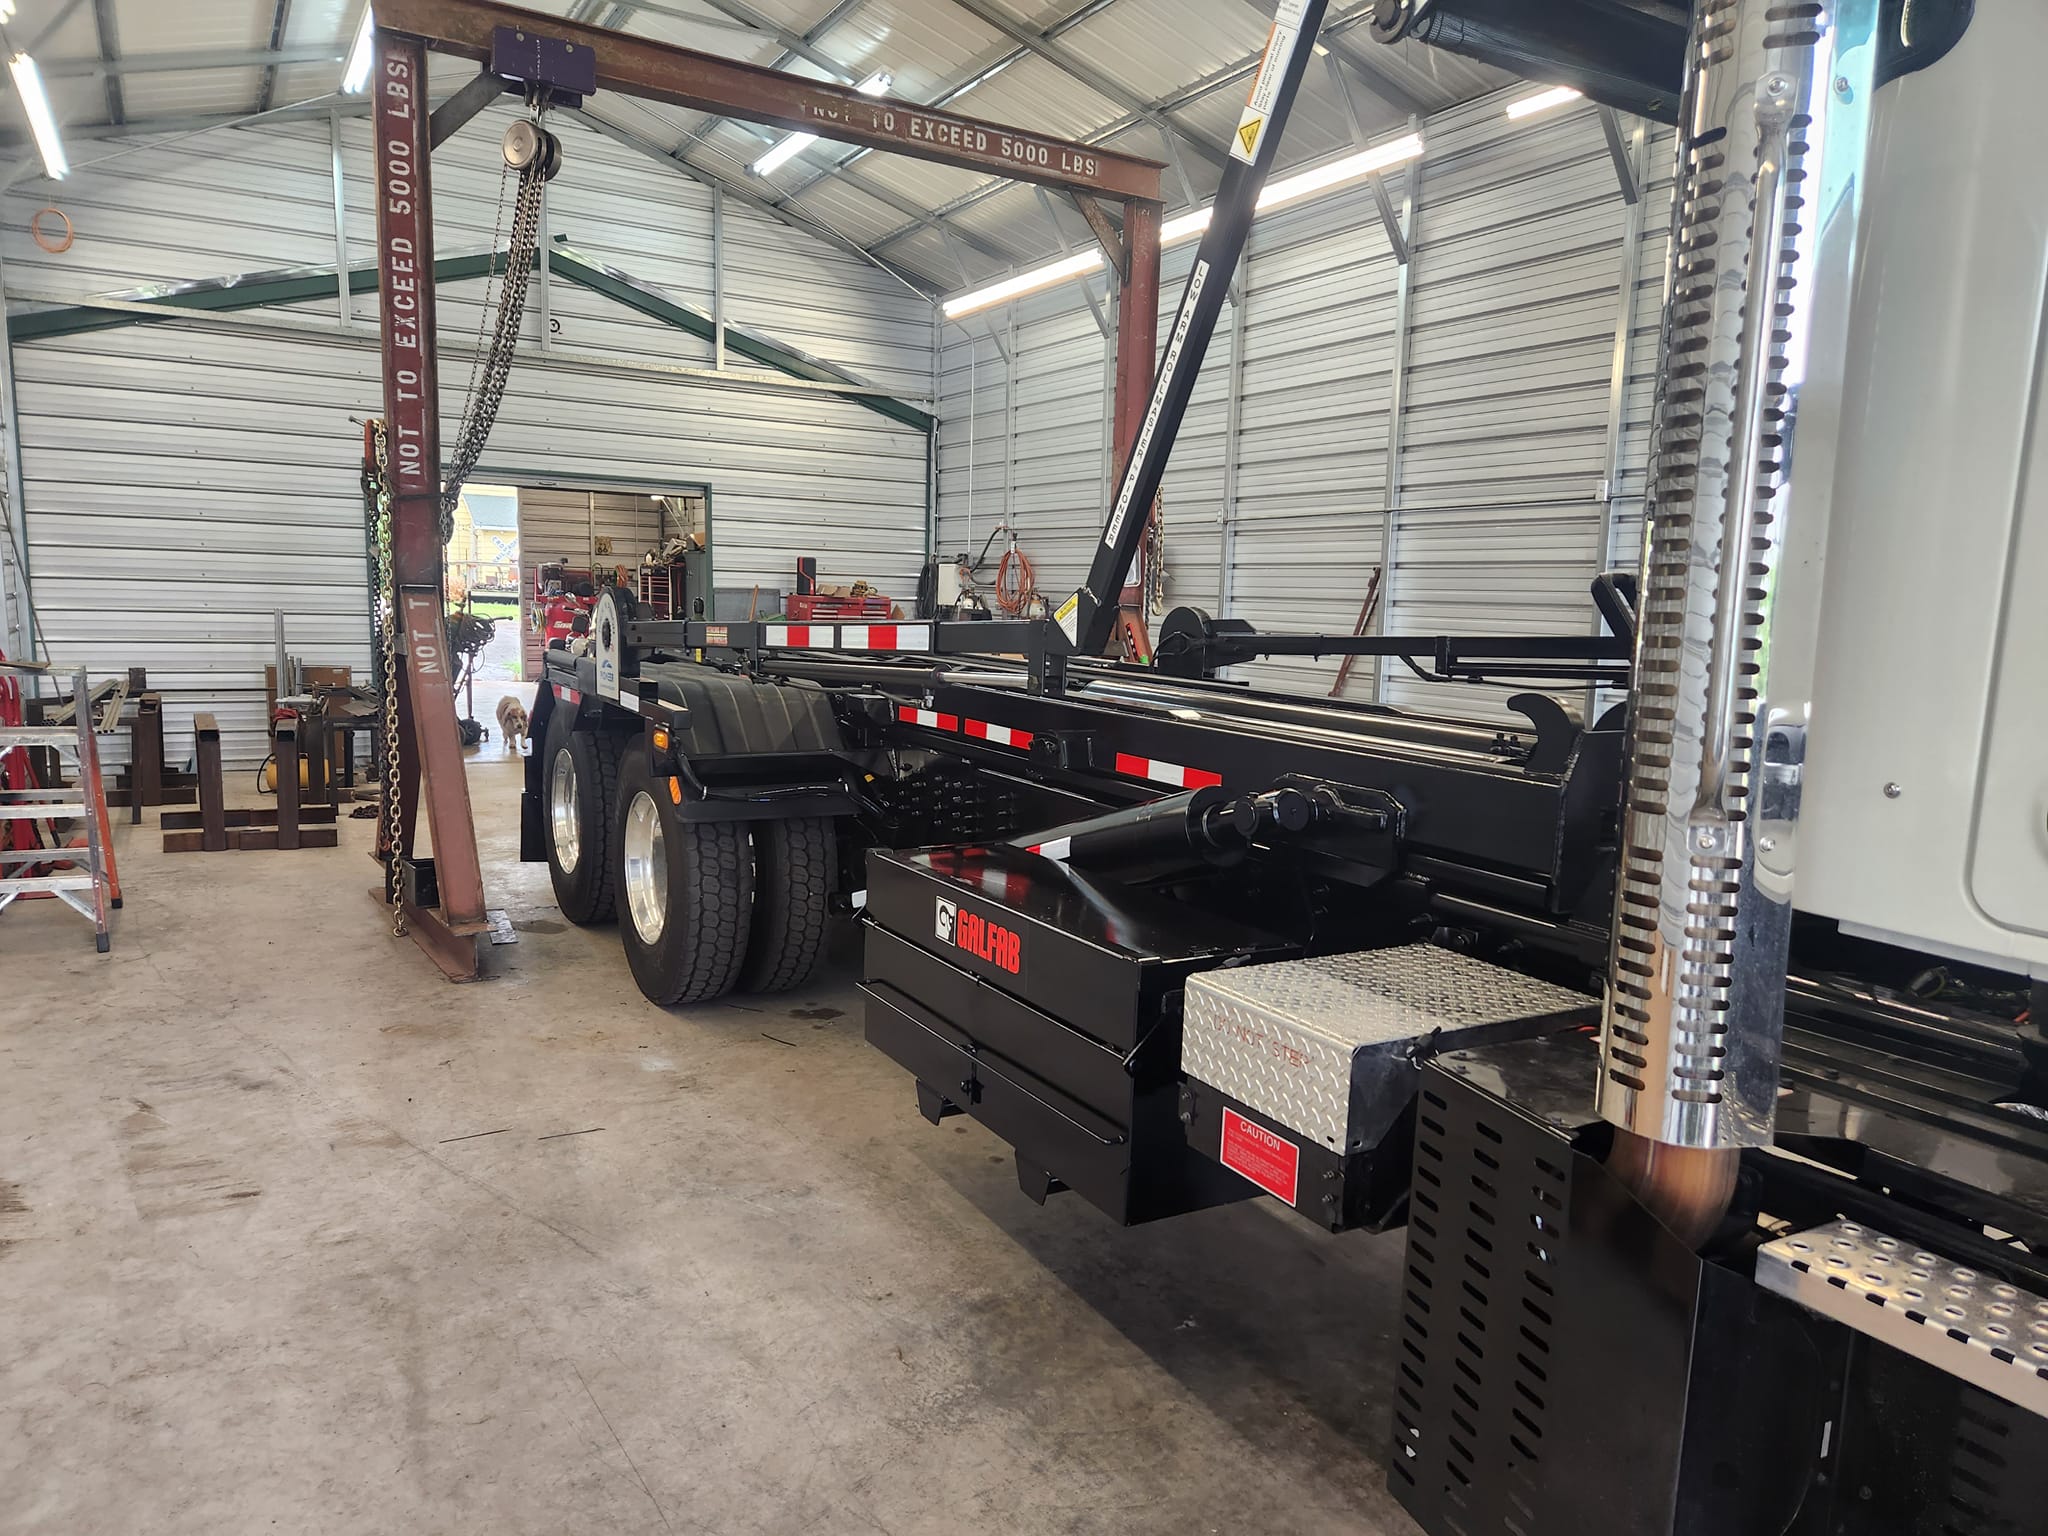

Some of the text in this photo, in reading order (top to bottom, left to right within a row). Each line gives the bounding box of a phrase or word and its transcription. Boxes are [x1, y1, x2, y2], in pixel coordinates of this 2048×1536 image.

[871, 109, 894, 131] TO
[911, 118, 987, 151] EXCEED
[1001, 137, 1048, 165] 5000
[1062, 152, 1095, 177] LBS
[387, 62, 421, 475] NOT TO EXCEED 5000 LBS
[1190, 266, 1203, 302] LOW
[1176, 310, 1189, 343] ARM
[1137, 350, 1177, 460] ROLLMASTER
[1108, 474, 1135, 544] PIONEER
[413, 629, 440, 673] NOT
[957, 909, 1021, 974] GALFAB
[1213, 1014, 1310, 1068] DO NOT STEP
[1240, 1121, 1280, 1151] CAUTION
